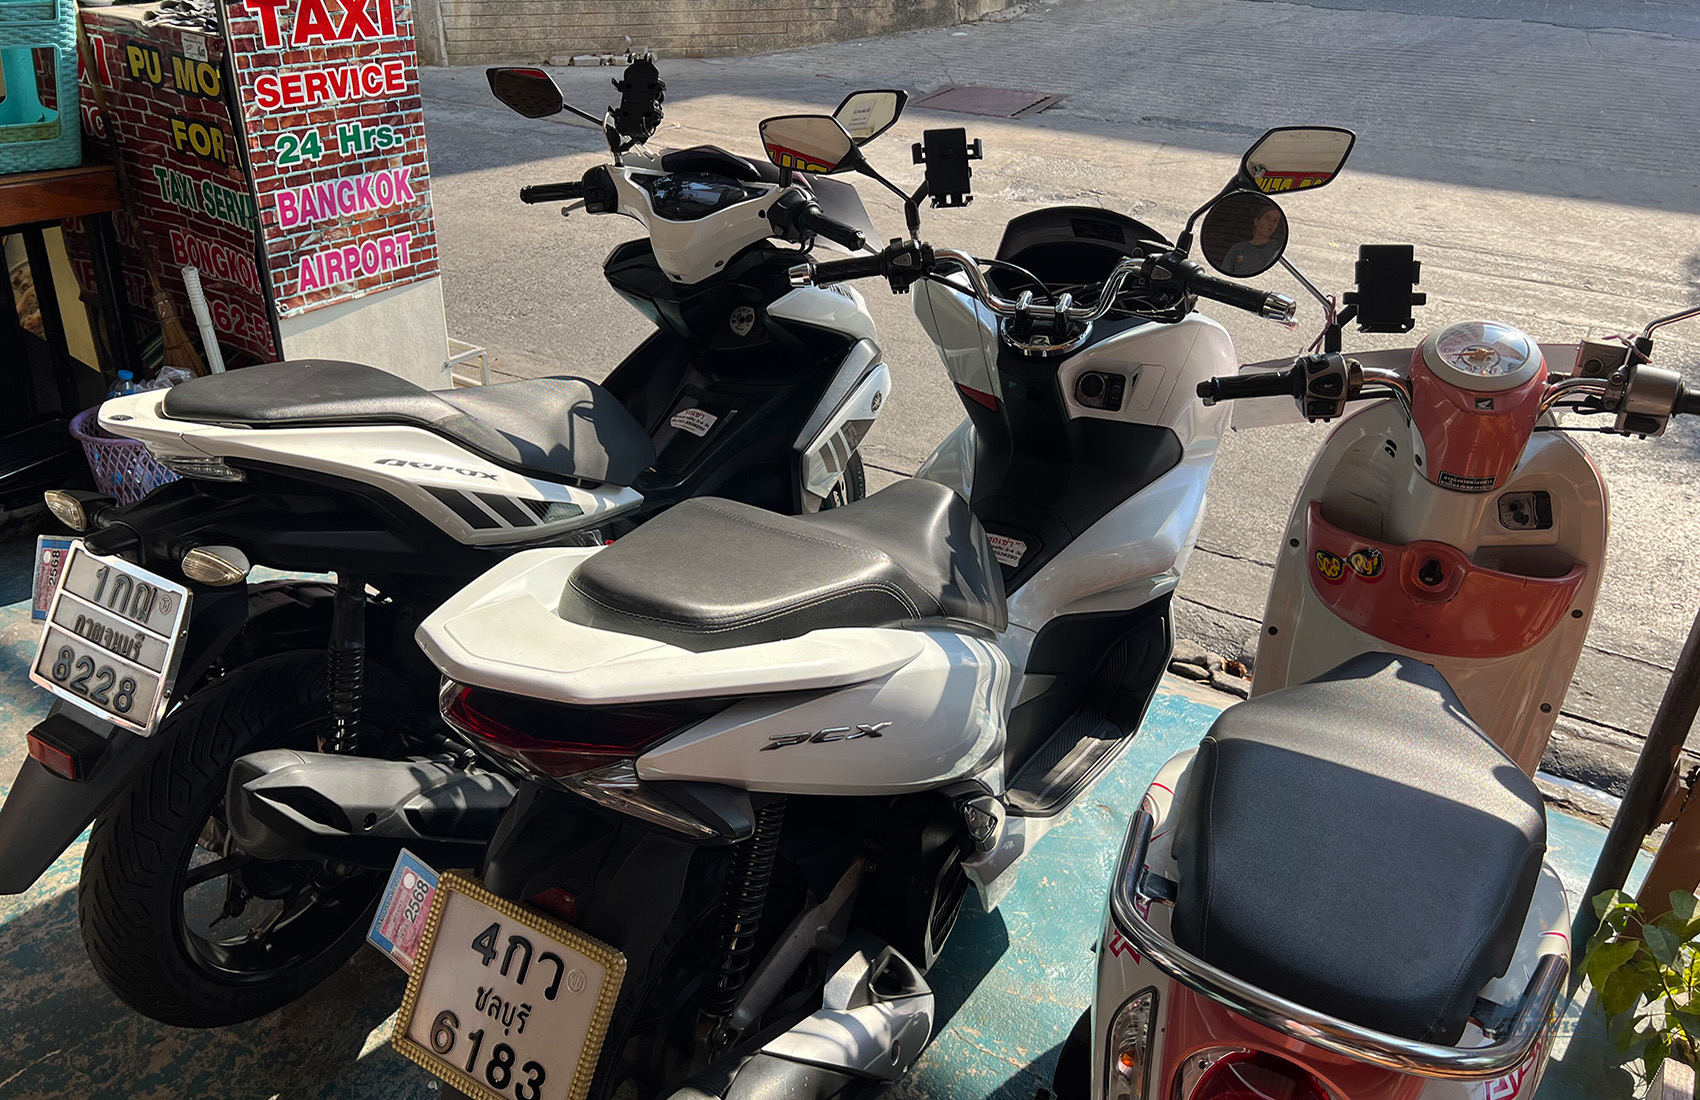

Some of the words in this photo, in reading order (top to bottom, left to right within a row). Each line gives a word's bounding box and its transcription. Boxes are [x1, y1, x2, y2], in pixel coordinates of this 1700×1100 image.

[246, 0, 397, 48] TAXI
[126, 45, 162, 84] PU
[172, 56, 221, 97] MO
[255, 61, 406, 109] SERVICE
[171, 118, 226, 163] FOR
[276, 134, 322, 166] 24
[338, 123, 403, 156] Hrs.
[153, 166, 199, 212] TAXI
[202, 179, 256, 231] SERVI
[276, 167, 415, 229] BANGKOK
[299, 233, 413, 293] AIRPORT
[208, 300, 277, 355] 62-5
[49, 549, 61, 586] 2568
[52, 645, 137, 713] 8228
[759, 722, 893, 751] PCX
[404, 879, 430, 924] 2568
[471, 922, 565, 1001] 4กว
[475, 987, 532, 1036] ชลบุรี
[430, 1010, 546, 1100] 6183
